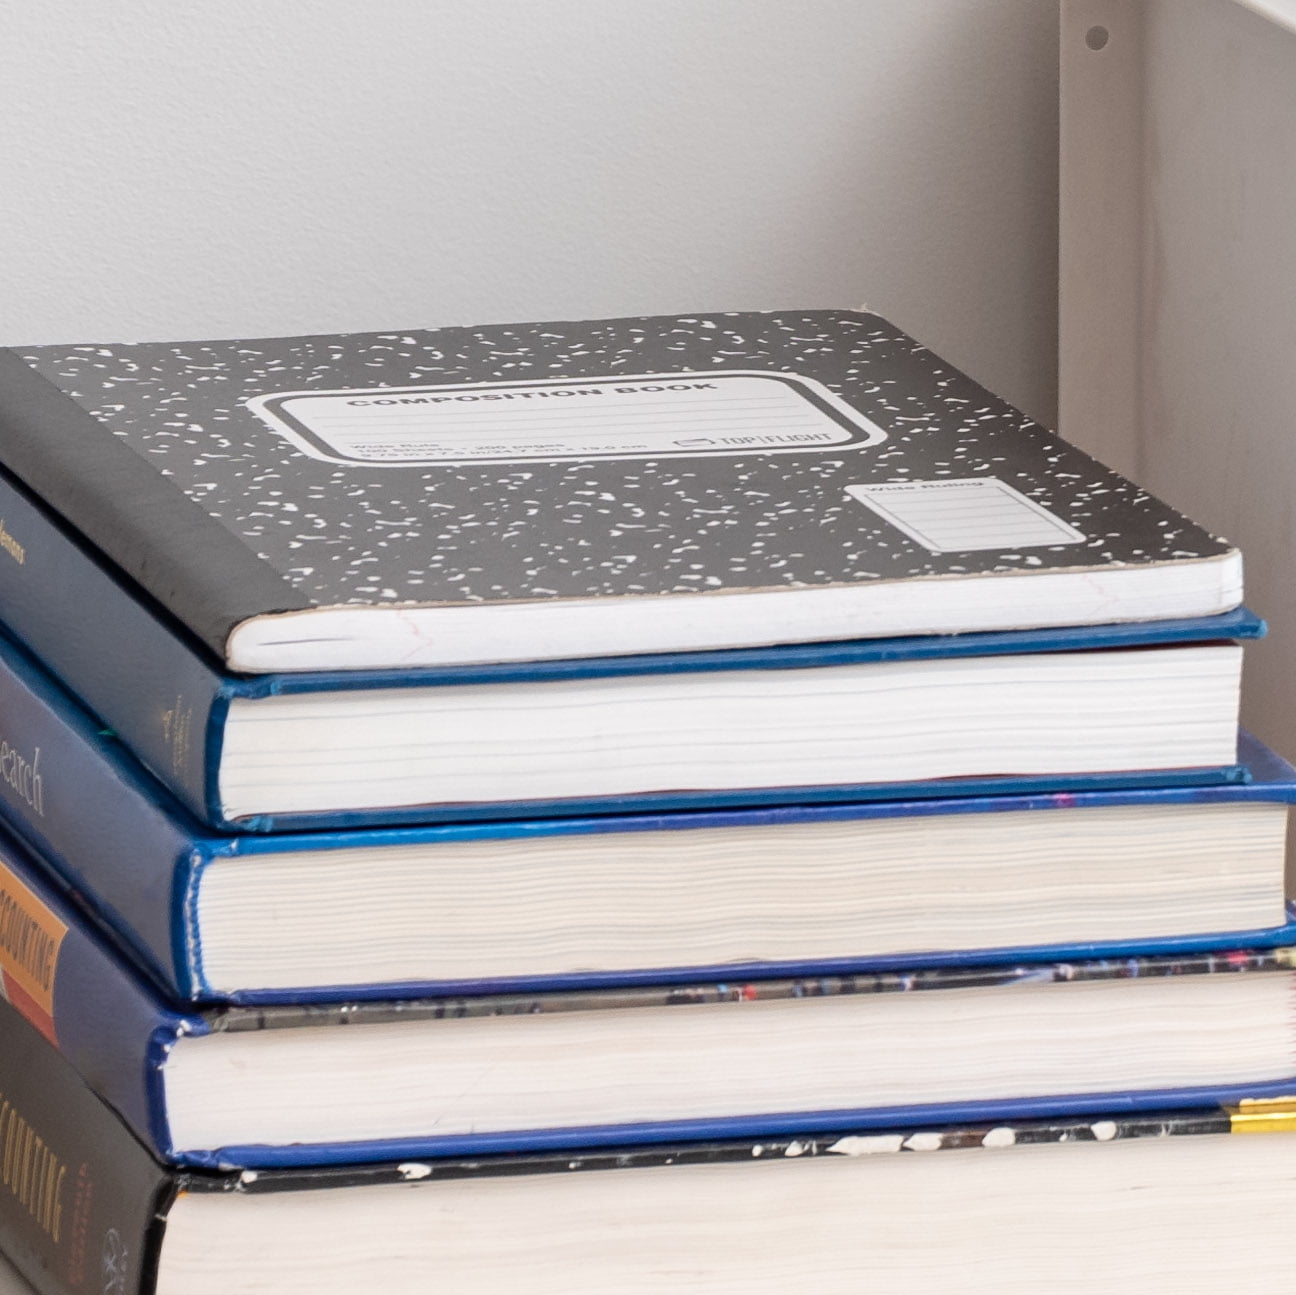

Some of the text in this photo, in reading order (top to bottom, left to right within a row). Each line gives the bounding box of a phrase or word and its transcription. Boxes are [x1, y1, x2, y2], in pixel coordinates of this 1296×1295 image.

[346, 383, 718, 406] COMPOSITION BOOK
[0, 741, 44, 817] earch
[0, 889, 55, 993] COUNTING
[0, 1094, 67, 1244] COUNTING
